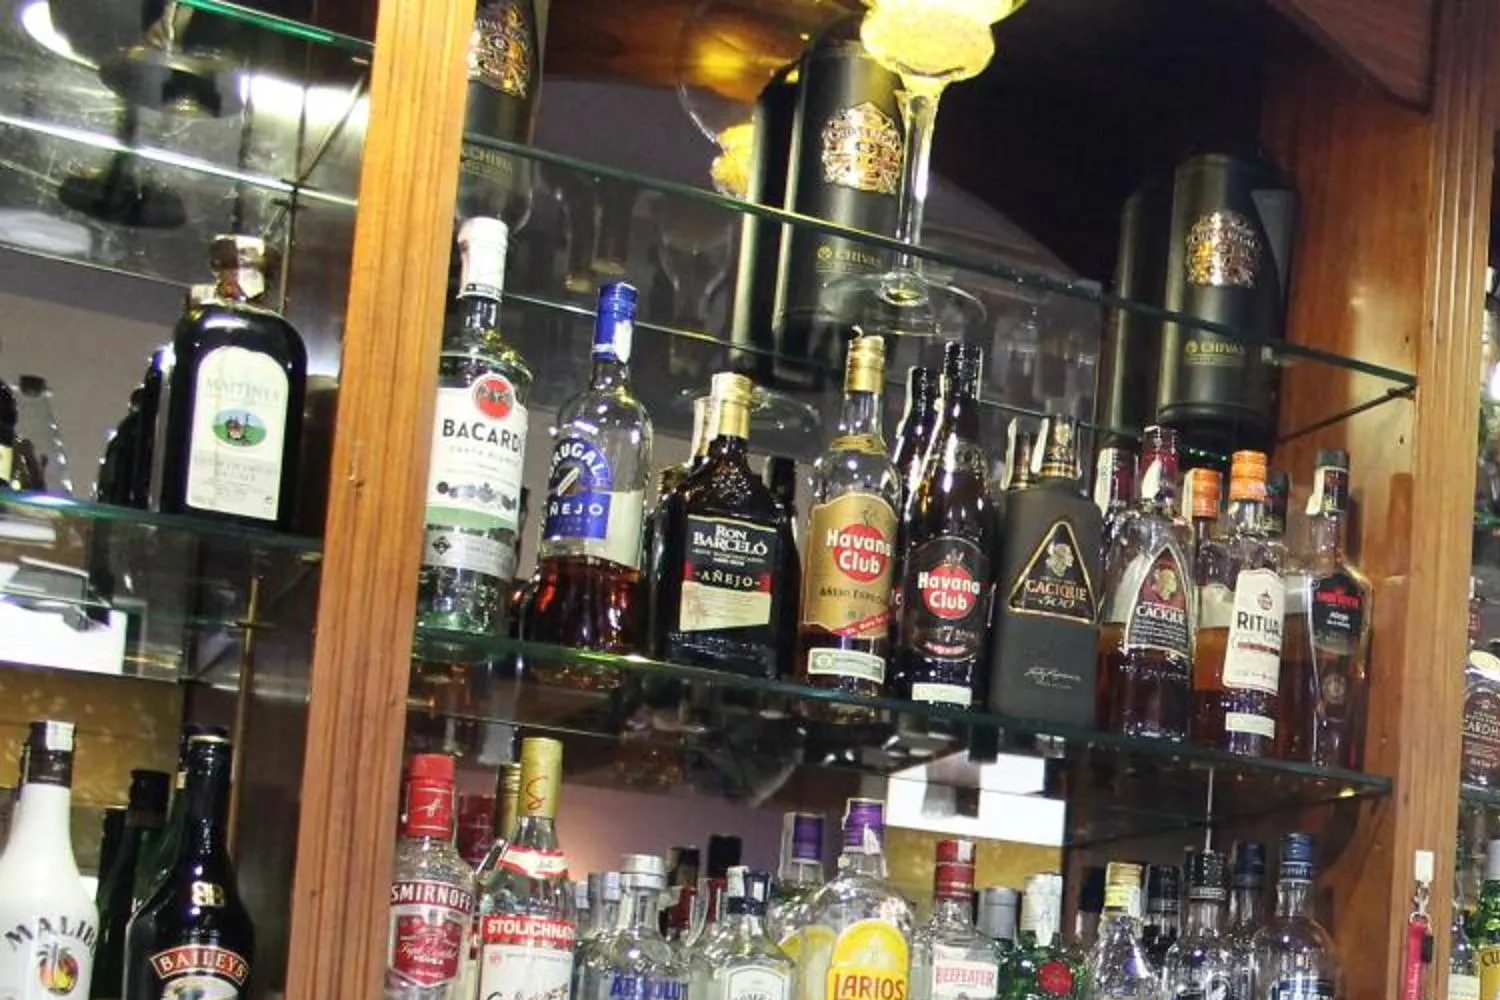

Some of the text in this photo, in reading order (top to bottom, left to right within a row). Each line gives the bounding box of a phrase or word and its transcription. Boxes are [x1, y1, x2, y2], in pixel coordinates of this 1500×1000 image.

[549, 501, 603, 517] ÑEJO
[692, 531, 768, 558] BARCELÓ
[715, 525, 747, 541] RON
[826, 528, 892, 557] Havana
[838, 551, 881, 575] Club
[917, 571, 981, 596] Havana
[1025, 578, 1087, 602] CACIQUE
[929, 590, 968, 611] Club
[1236, 611, 1281, 636] RITUA
[487, 917, 575, 941] STOLICHNAY
[159, 949, 247, 984] BAILEYS
[935, 965, 994, 989] BEEFEATER
